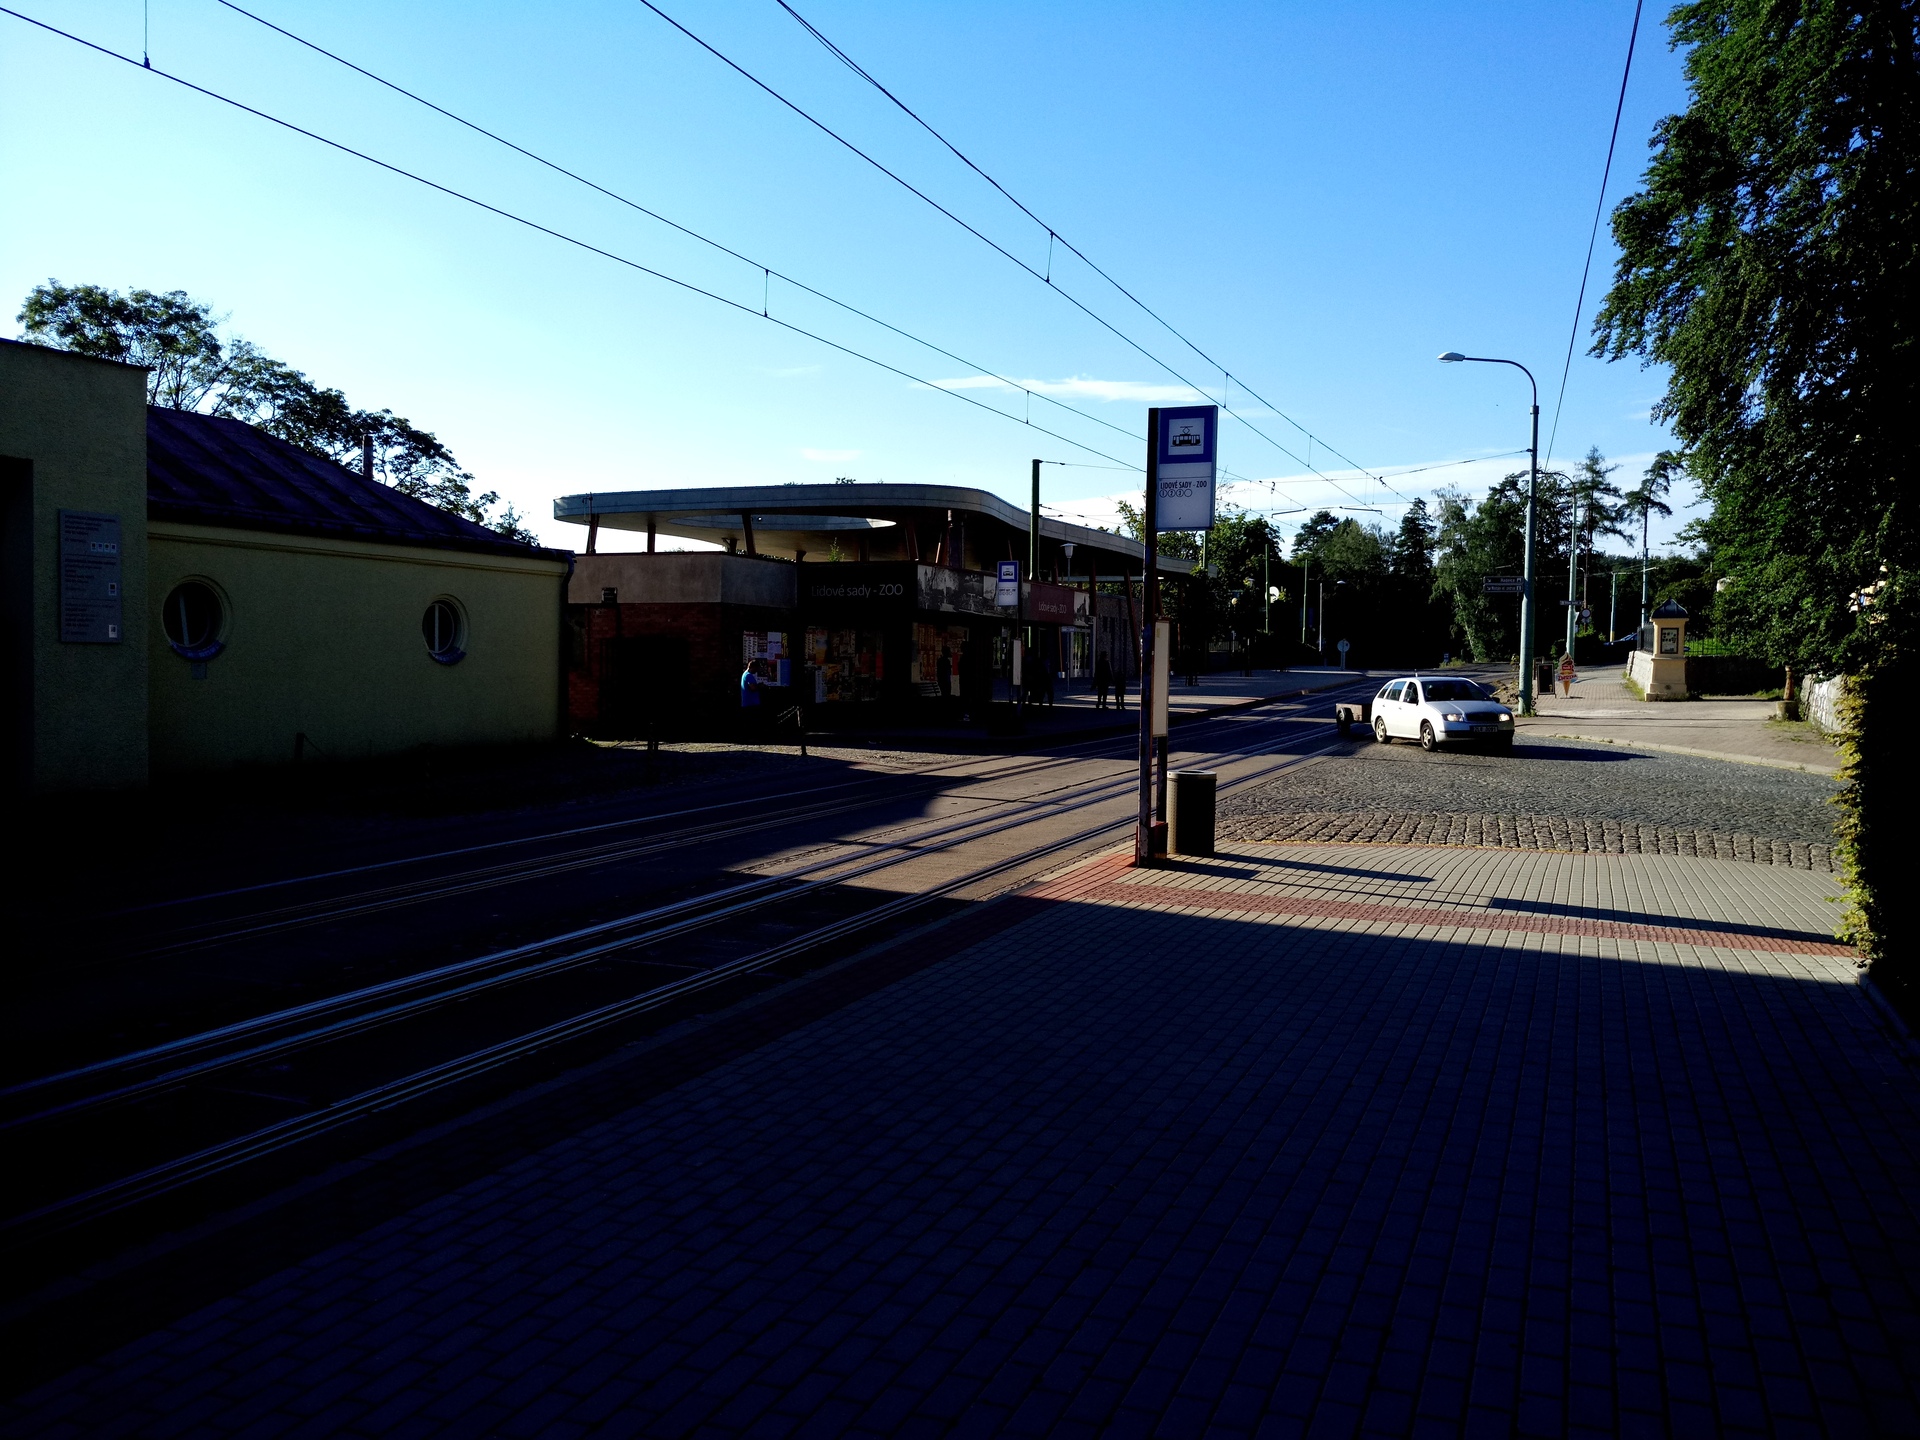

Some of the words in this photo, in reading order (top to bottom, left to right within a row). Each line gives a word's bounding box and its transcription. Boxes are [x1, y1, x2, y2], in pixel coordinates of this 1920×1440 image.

[1160, 480, 1178, 489] LIDOVÉ
[1196, 480, 1208, 488] ZOO
[811, 584, 844, 596] Lidové
[846, 584, 871, 598] sady
[878, 583, 904, 596] ZOO
